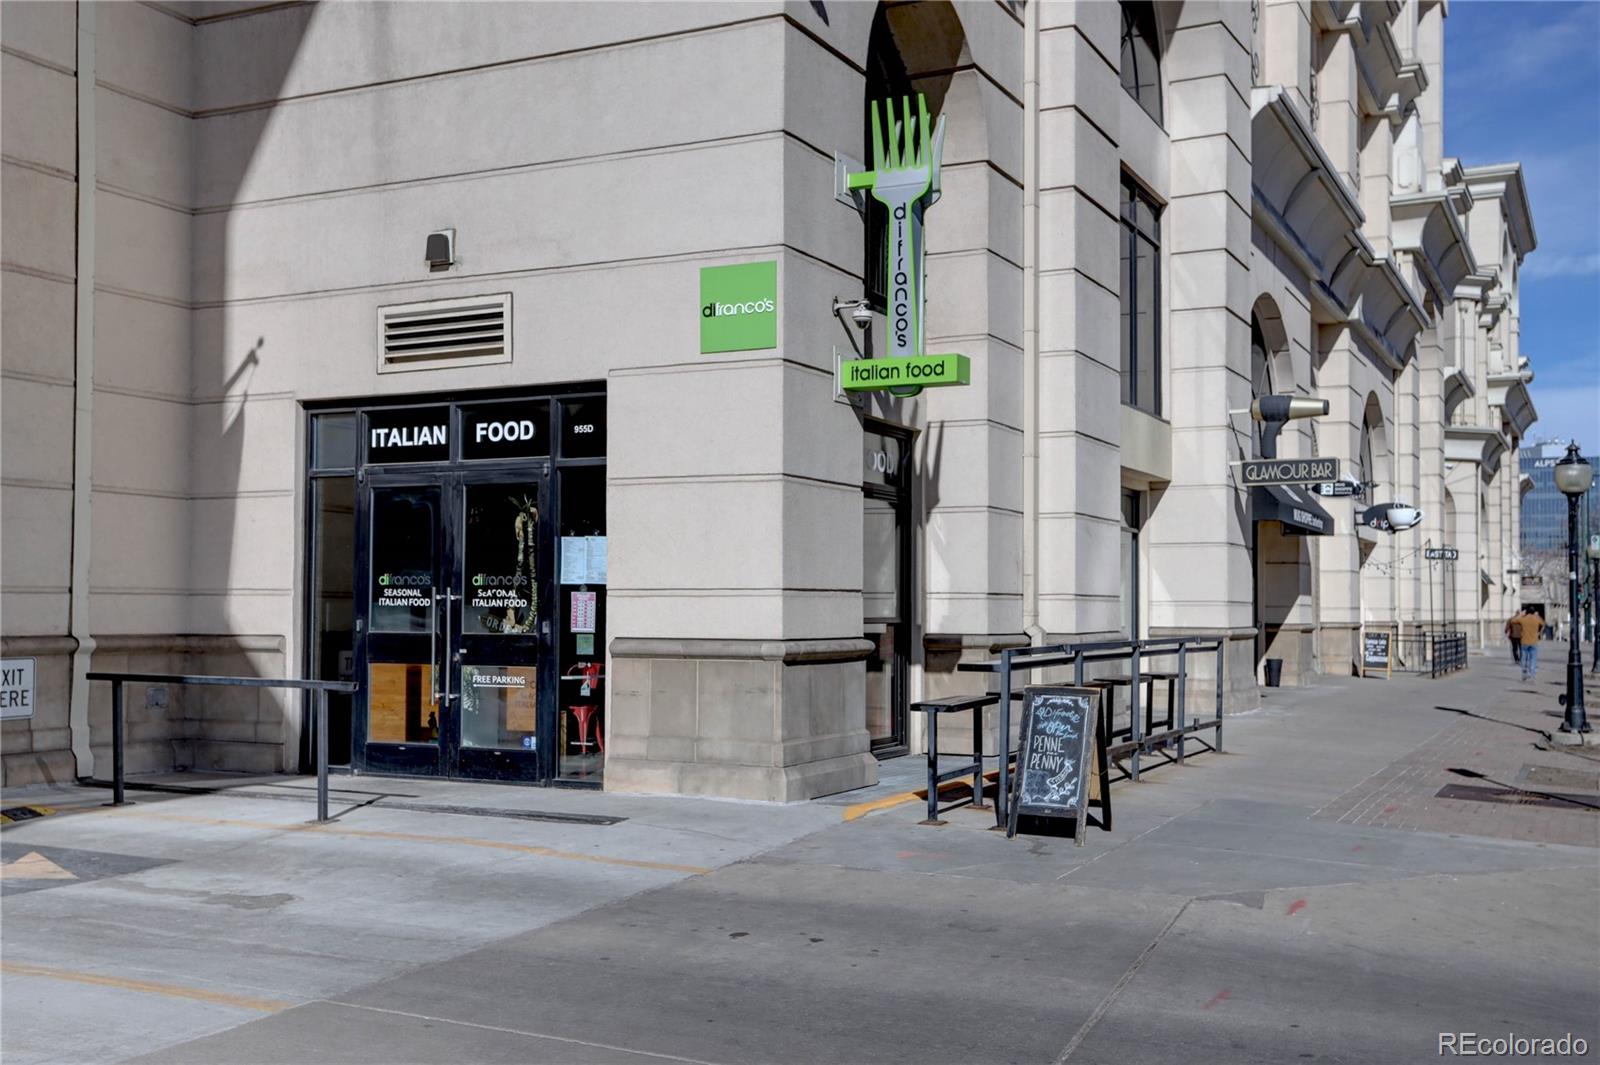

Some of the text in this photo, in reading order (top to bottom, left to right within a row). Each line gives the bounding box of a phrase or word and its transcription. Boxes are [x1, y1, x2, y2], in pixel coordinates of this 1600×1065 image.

[702, 297, 774, 318] difranco's
[850, 360, 945, 381] italian food
[371, 420, 535, 448] ITALIAN FOOD
[574, 424, 594, 434] 955D
[1246, 462, 1332, 480] GLAMOUR BAR
[1370, 517, 1389, 530] drip
[383, 588, 422, 597] SEASONAL
[378, 598, 431, 607] ITALIAN FOOD
[472, 599, 528, 608] ITALIAN FOOD
[2, 668, 25, 686] XIT
[472, 675, 526, 685] FREE PARKING
[0, 690, 29, 708] ERE
[1033, 735, 1065, 753] PENNE
[1030, 753, 1064, 773] PENNY
